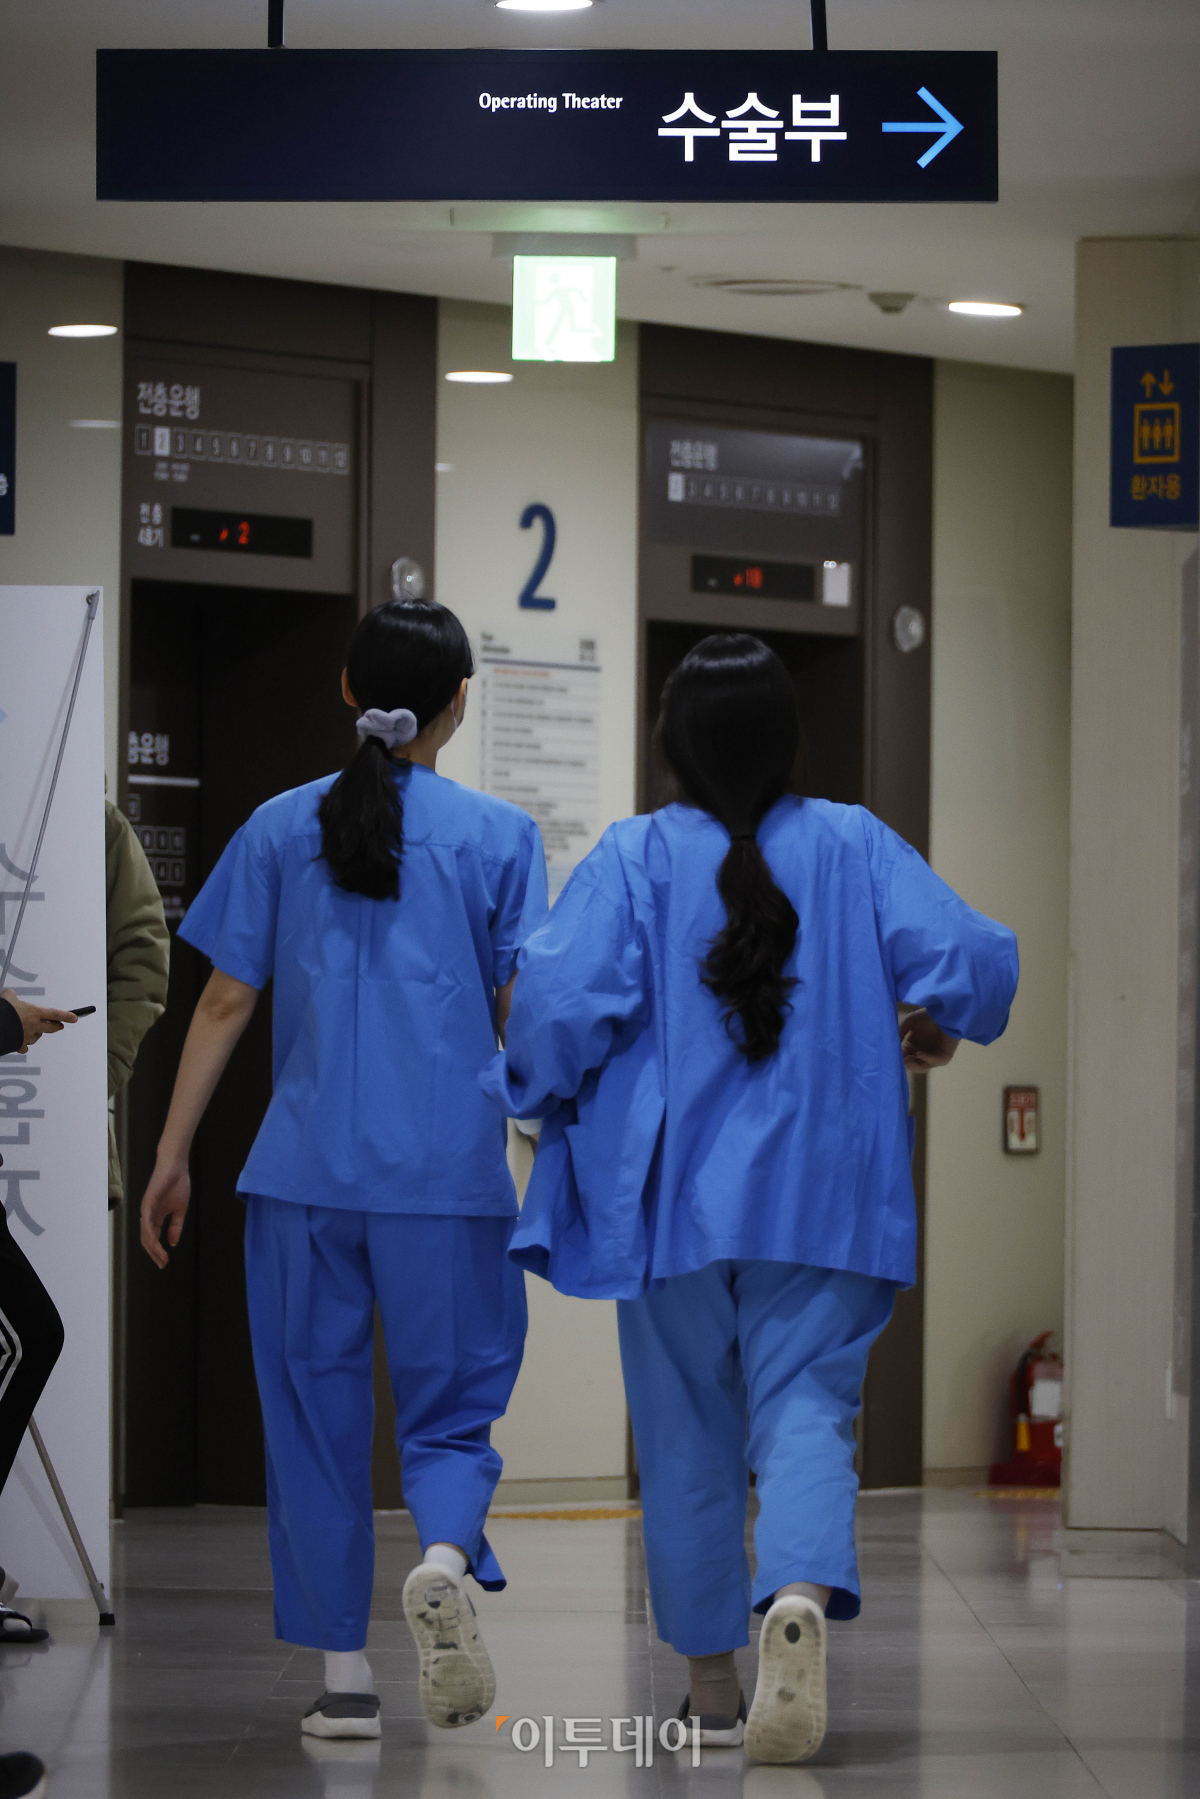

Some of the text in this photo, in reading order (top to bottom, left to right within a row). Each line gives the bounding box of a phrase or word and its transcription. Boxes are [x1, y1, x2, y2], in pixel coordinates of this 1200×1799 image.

[478, 92, 623, 113] Operating Theater
[658, 92, 847, 162] 수술부
[137, 382, 200, 419] 전층운행
[1131, 474, 1181, 500] 환자용
[238, 521, 250, 545] 2
[519, 503, 556, 608] 2
